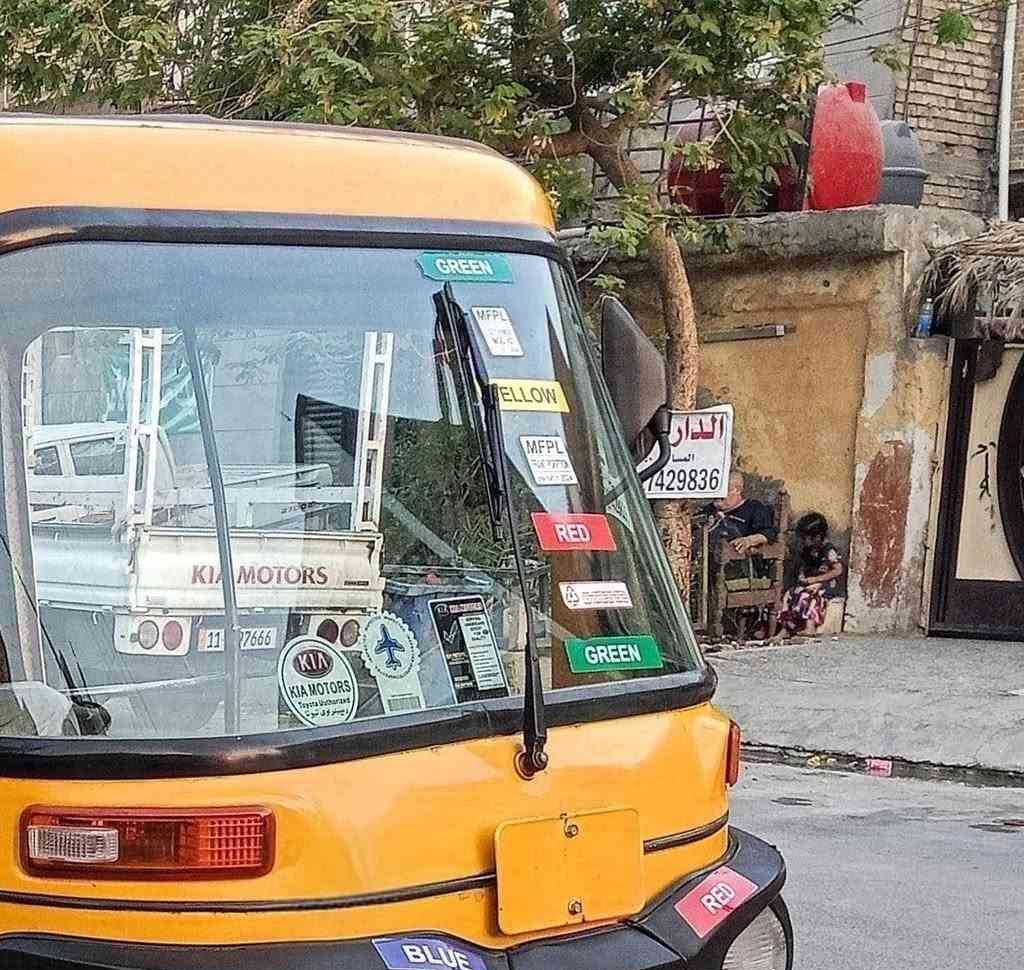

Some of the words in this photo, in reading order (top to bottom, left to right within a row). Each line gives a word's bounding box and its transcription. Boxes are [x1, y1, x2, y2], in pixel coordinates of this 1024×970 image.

[435, 258, 493, 276] GREEN
[476, 309, 508, 322] MFPL
[495, 386, 558, 405] ELLOW
[671, 414, 725, 448] الدار
[526, 439, 565, 454] MFPL
[555, 523, 592, 544] RED
[236, 564, 329, 586] MOTORS
[297, 652, 330, 672] KIA
[584, 643, 642, 665] GREEN
[288, 684, 308, 699] KIA
[308, 680, 351, 697] MOTORS
[700, 881, 736, 915] RED
